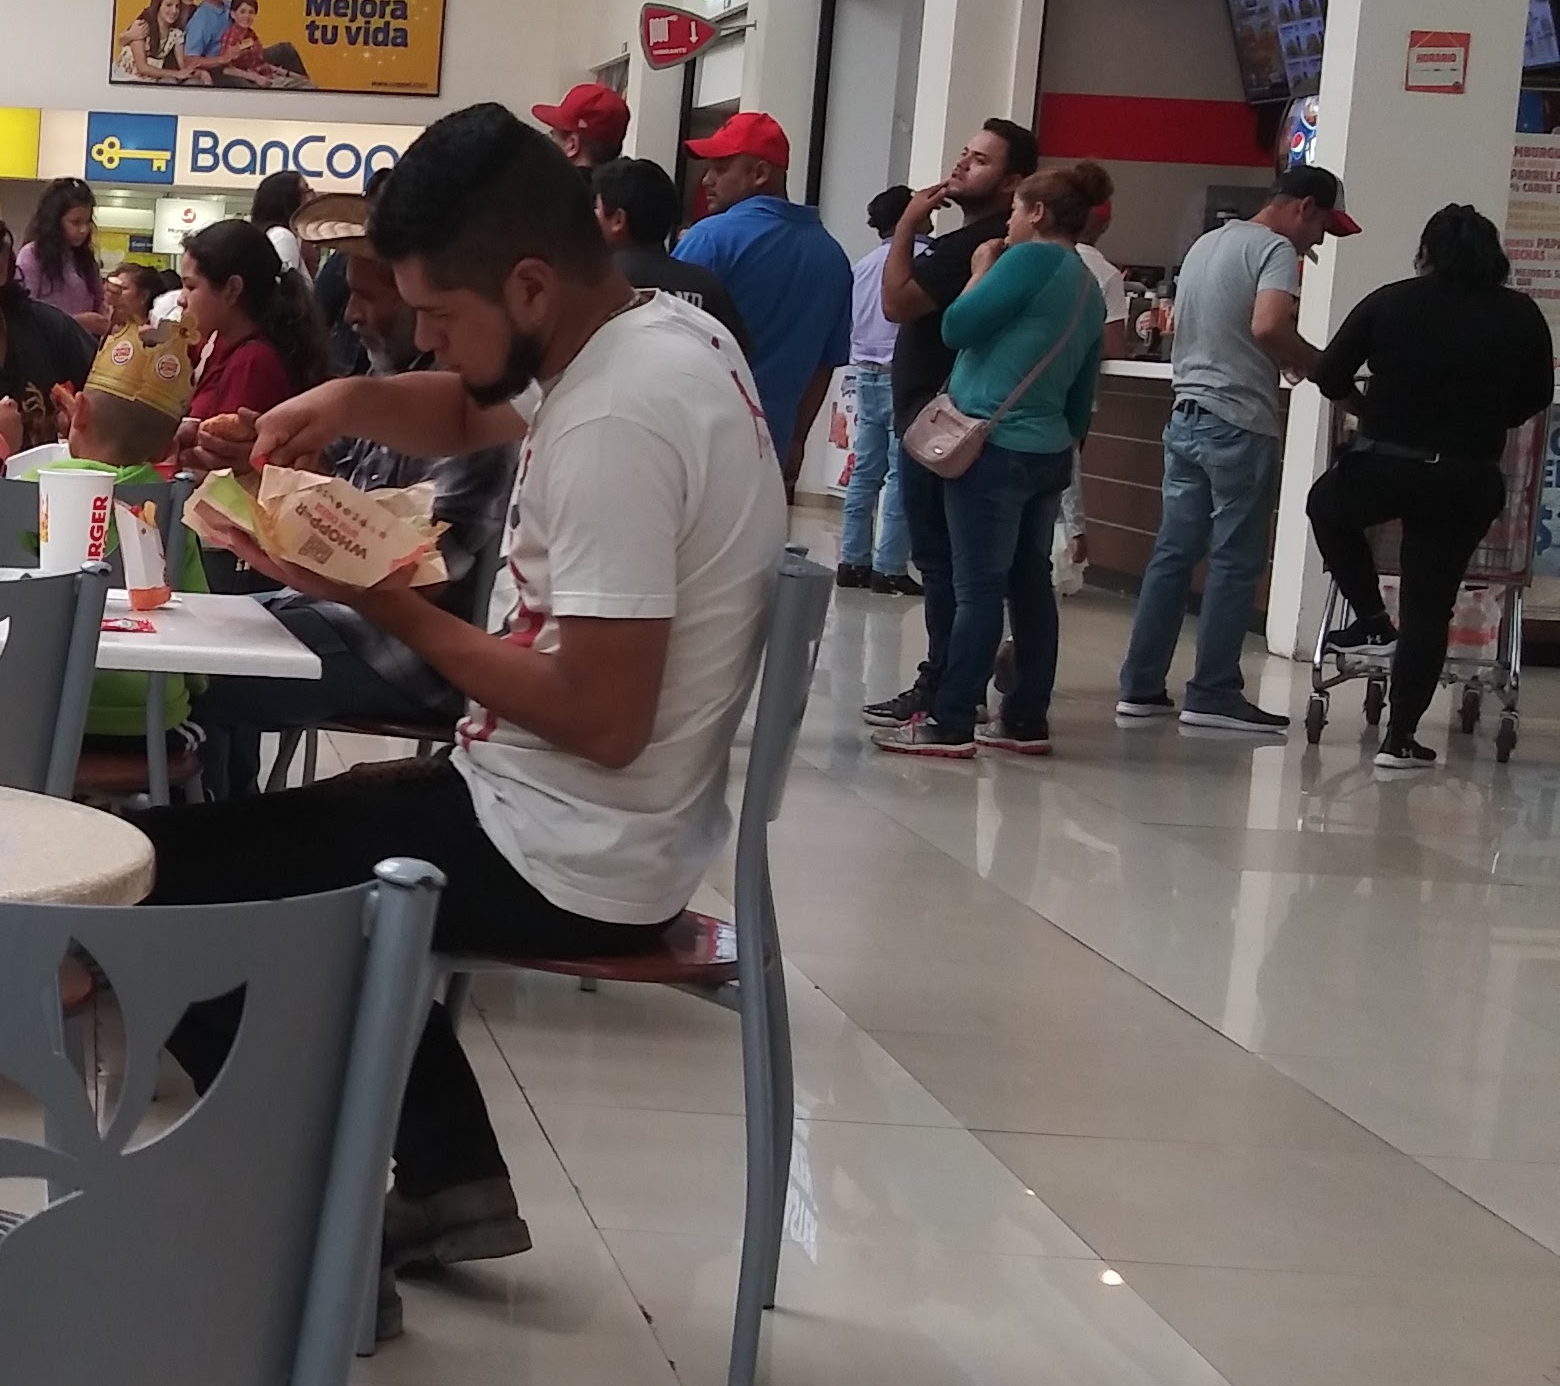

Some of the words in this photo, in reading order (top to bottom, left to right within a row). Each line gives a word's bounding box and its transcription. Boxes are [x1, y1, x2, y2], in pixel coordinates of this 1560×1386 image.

[305, 19, 339, 45] tu
[344, 20, 409, 48] vida
[86, 495, 109, 561] RGER
